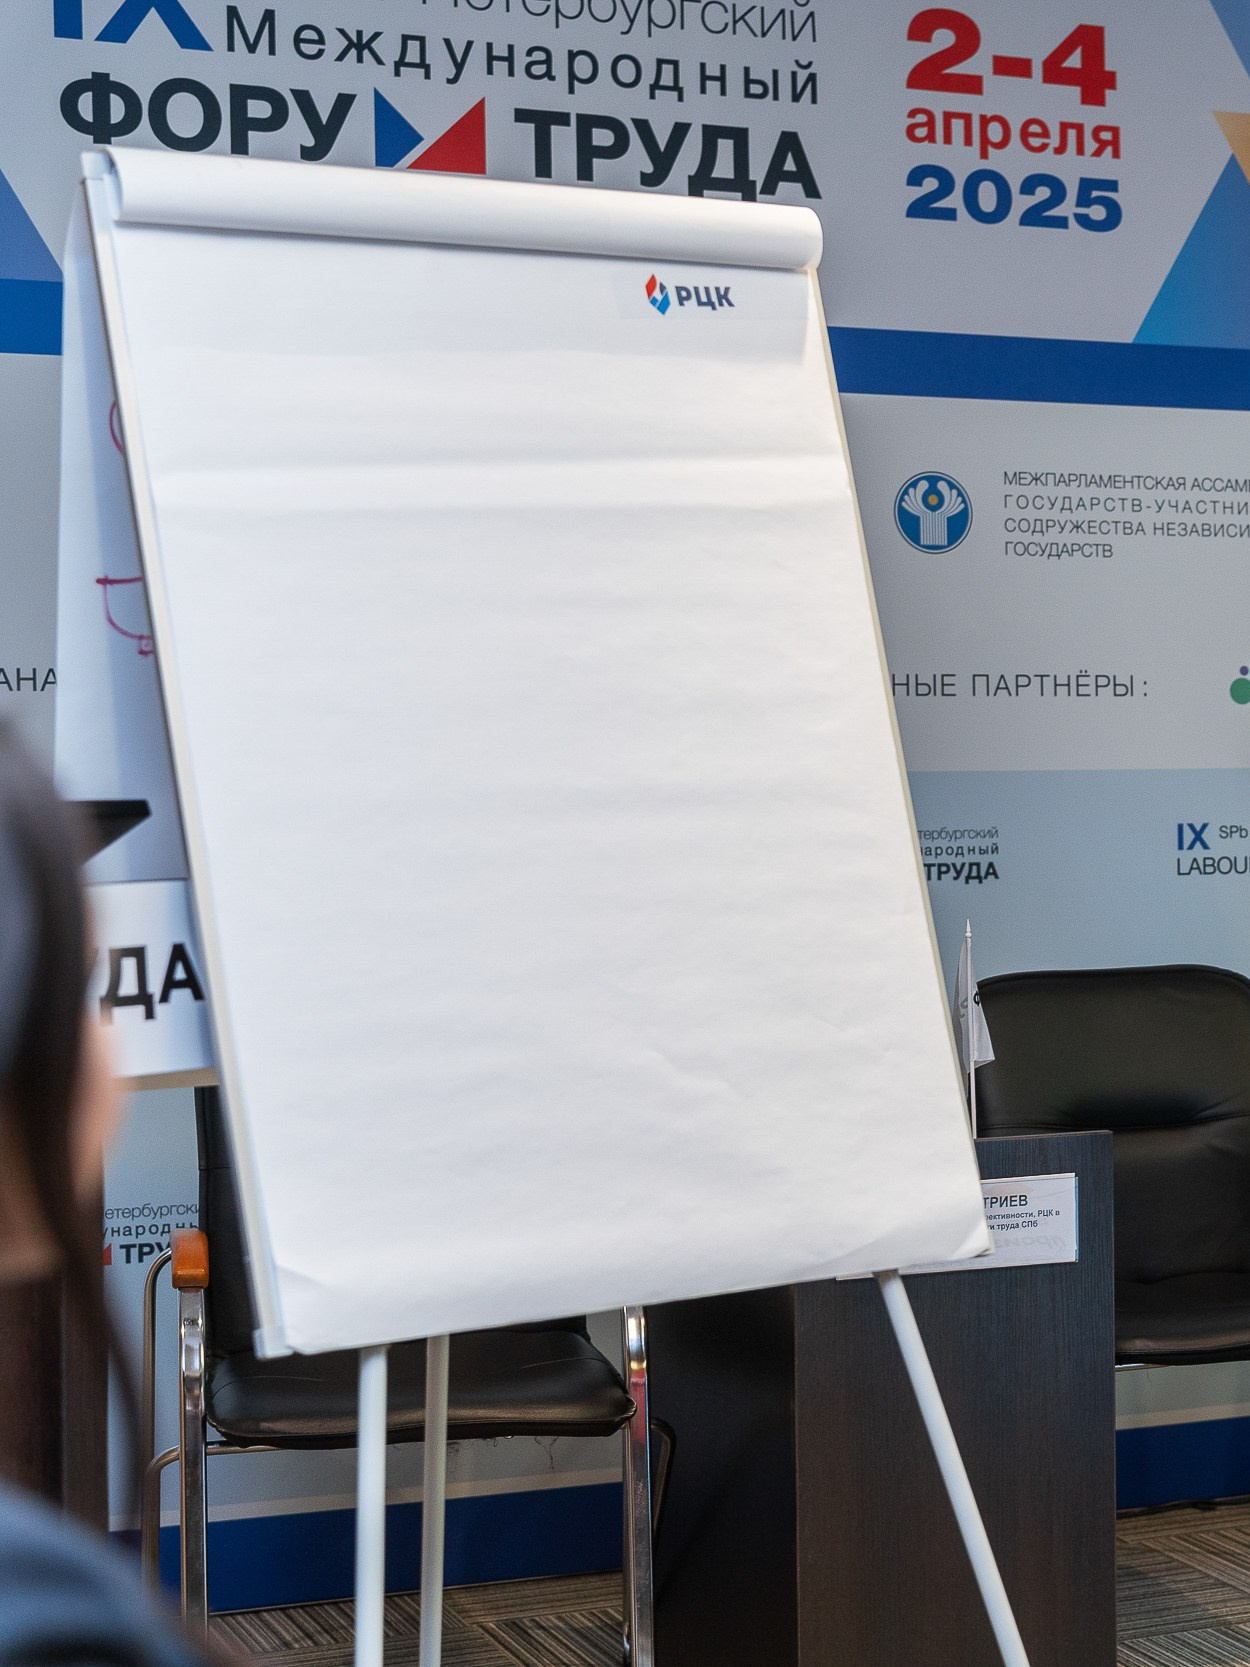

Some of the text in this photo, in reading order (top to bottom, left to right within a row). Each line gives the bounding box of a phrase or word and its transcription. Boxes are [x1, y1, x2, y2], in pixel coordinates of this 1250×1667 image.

[226, 5, 819, 105] Международный
[906, 7, 1118, 108] 2-4
[905, 107, 1122, 160] апреля
[514, 107, 823, 203] ТРУДА
[905, 164, 1123, 233] 2025
[675, 286, 736, 311] РЦК
[1003, 471, 1186, 491] МЕЖПАРЛАМЕНТСКАЯ
[1004, 518, 1146, 537] СОДРУЖЕСТВА
[1004, 541, 1114, 560] ГОСУДАРСТВ
[1177, 822, 1211, 851] IX
[1219, 825, 1249, 839] SPb
[923, 861, 1000, 884] ТРУДА
[983, 1194, 1028, 1209] ТРИЕВ
[1037, 1208, 1053, 1219] РЦК
[996, 1222, 1019, 1232] труда
[1022, 1219, 1038, 1229] СПб
